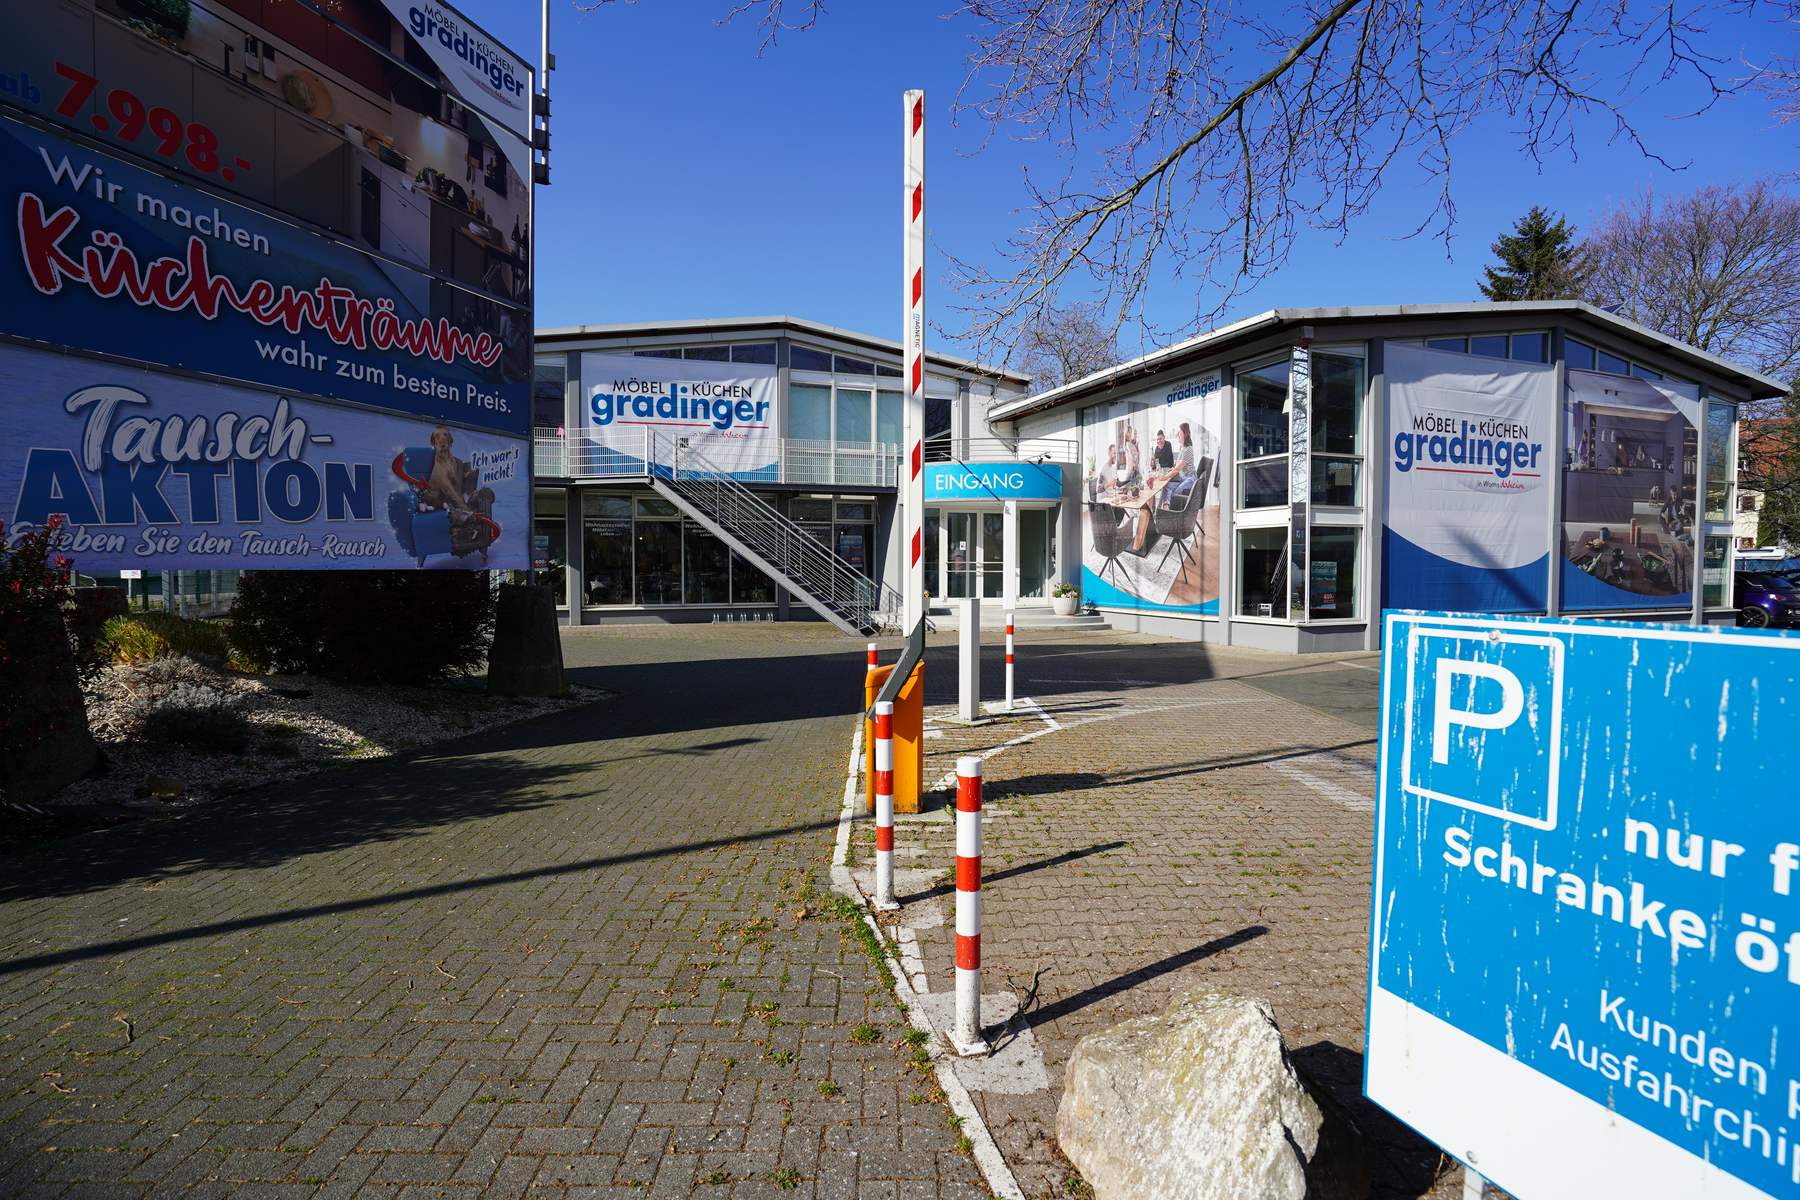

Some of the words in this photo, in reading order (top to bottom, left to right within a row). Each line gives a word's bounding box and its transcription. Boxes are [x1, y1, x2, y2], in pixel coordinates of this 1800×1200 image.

[409, 7, 524, 97] gradinger
[424, 4, 460, 36] MÖBEL
[476, 41, 514, 74] KÜCHEN
[0, 71, 41, 104] ab
[38, 146, 123, 204] Wir
[137, 193, 270, 255] machen
[18, 192, 502, 367] Küchenträume
[255, 337, 328, 373] wahr
[336, 359, 385, 386] zum
[393, 370, 460, 402] besten
[466, 384, 512, 414] Preis.
[591, 382, 769, 430] gradinger
[612, 376, 665, 395] MÖBEL
[692, 382, 752, 399] KÜCHEN
[1166, 379, 1220, 408] gradinger
[65, 385, 333, 472] Tausch-
[1394, 420, 1542, 479] gradinger
[1413, 411, 1457, 434] MÖBEL
[1479, 418, 1528, 440] KÜCHEN
[13, 447, 375, 528] AKTION
[471, 452, 488, 469] Ich
[484, 462, 515, 482] nicht!
[935, 472, 1024, 492] EINGANG
[134, 526, 181, 556] Sie
[187, 530, 231, 555] den
[239, 530, 386, 558] Tausch-Rausch
[1431, 656, 1524, 766] P
[1624, 816, 1745, 878] nur
[1442, 826, 1707, 949] Schranke
[1600, 989, 1767, 1096] Kunden
[1551, 1022, 1800, 1185] Ausfahrchi
